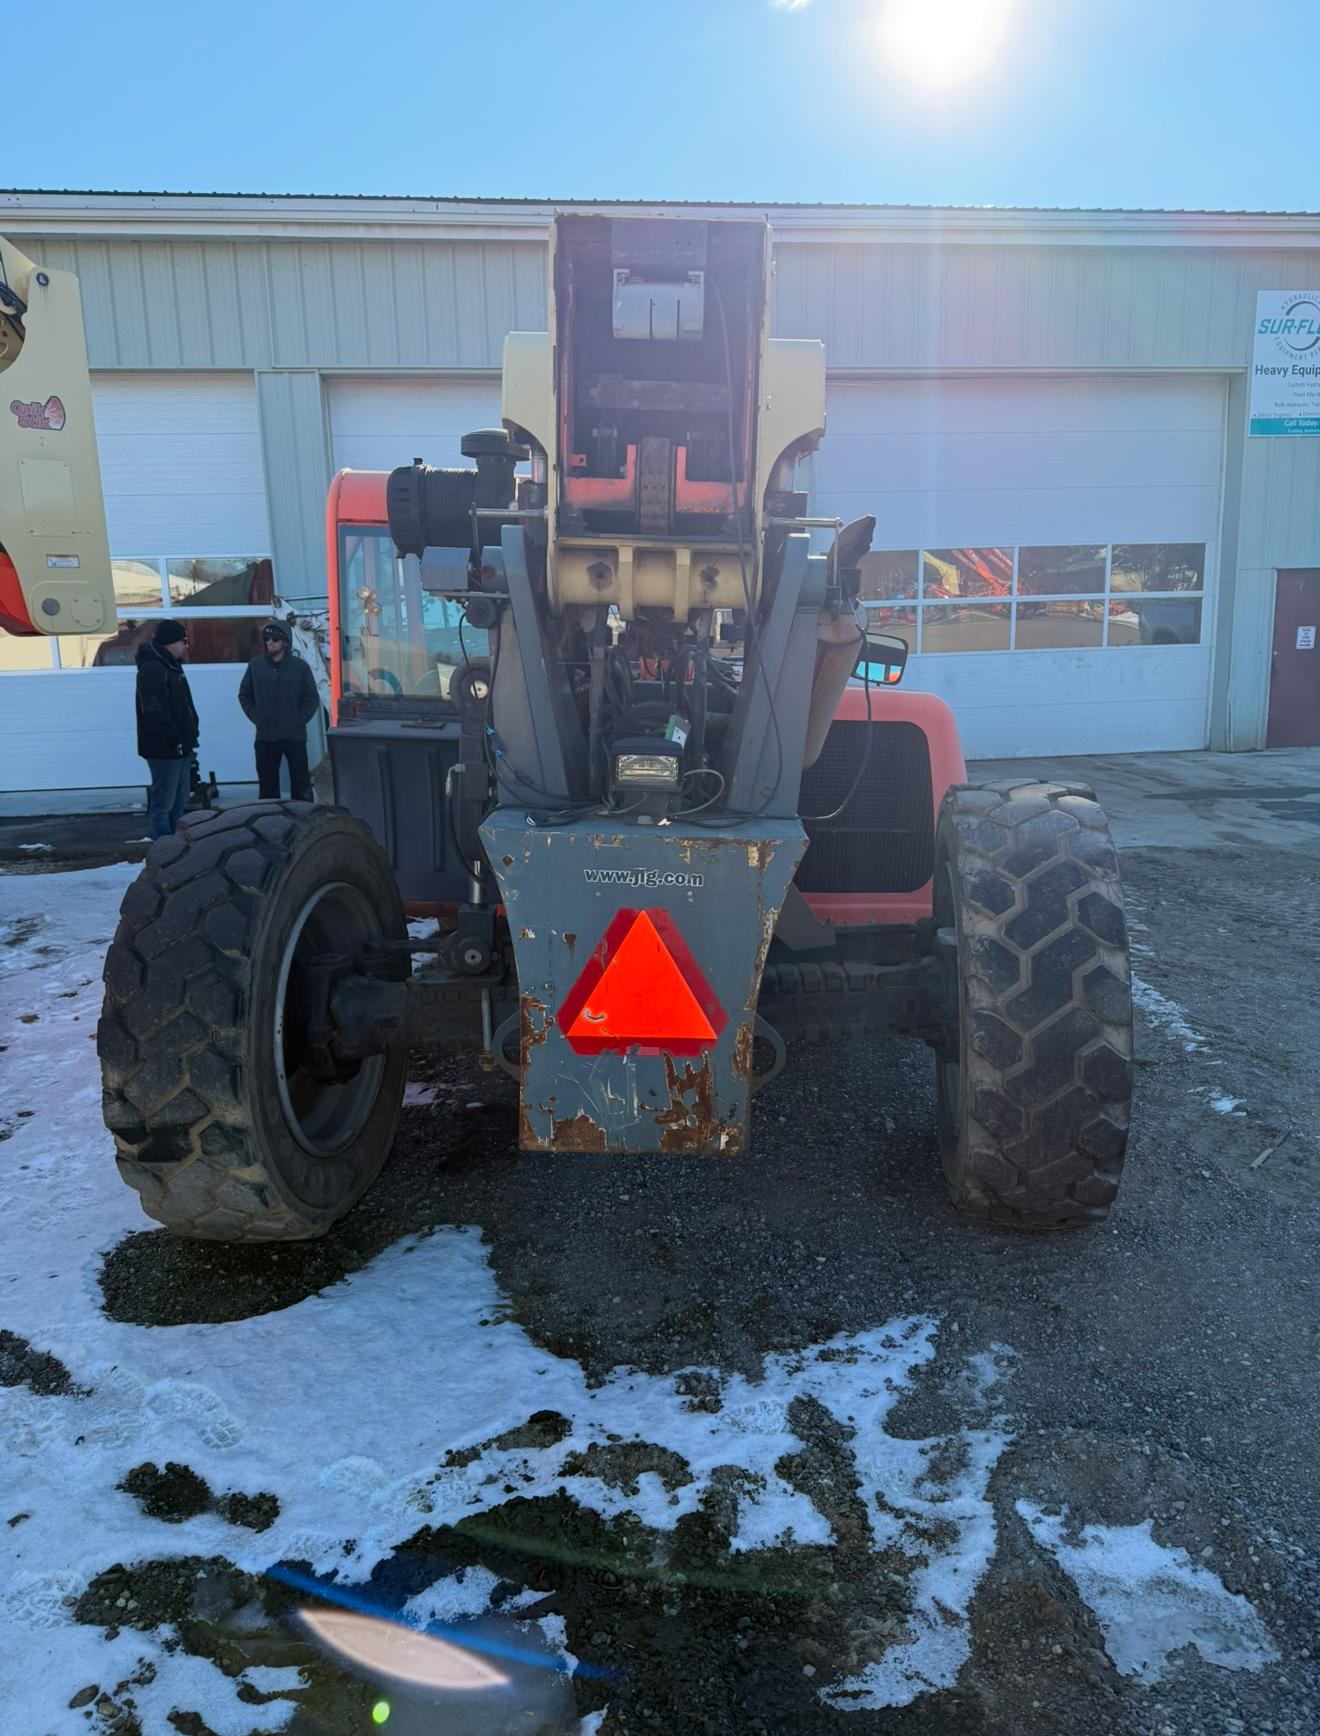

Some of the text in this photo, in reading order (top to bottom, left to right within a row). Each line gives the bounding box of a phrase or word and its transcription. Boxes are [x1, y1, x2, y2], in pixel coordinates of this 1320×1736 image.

[1274, 336, 1307, 360] EQUIPMENT
[1255, 364, 1289, 378] Heavy
[11, 401, 45, 416] Quik
[18, 415, 49, 428] Stik
[1298, 419, 1320, 428] Today:
[584, 867, 704, 887] www.jlg.com
